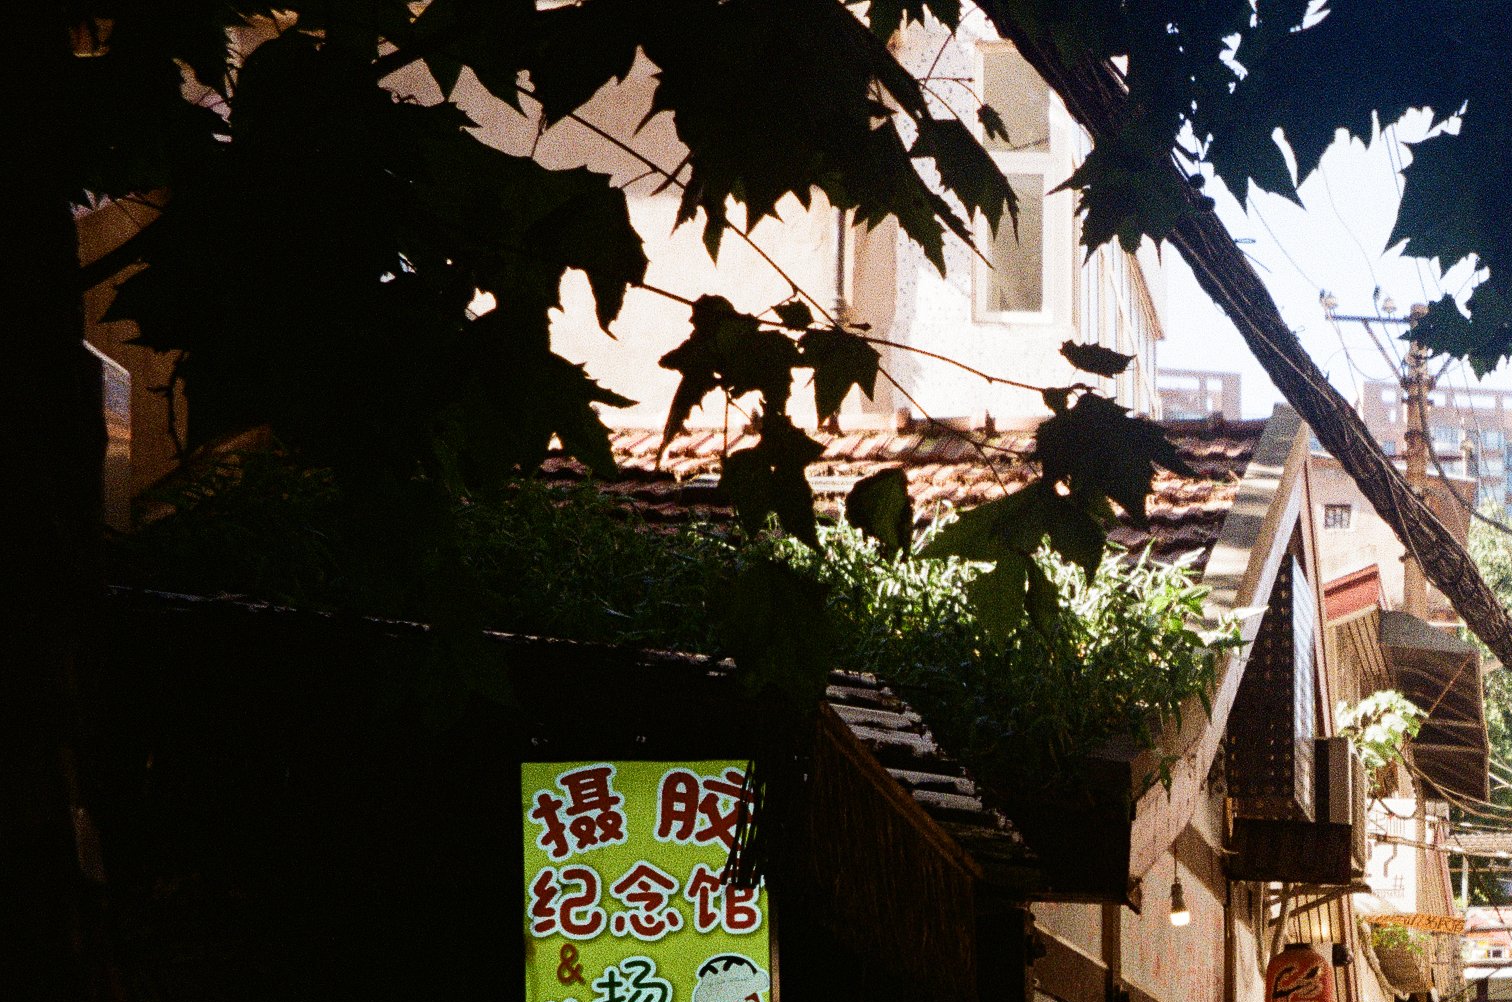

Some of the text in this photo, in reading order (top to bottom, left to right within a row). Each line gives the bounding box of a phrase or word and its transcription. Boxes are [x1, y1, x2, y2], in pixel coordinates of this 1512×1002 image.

[531, 766, 757, 859] 摄胶
[531, 865, 762, 938] 纪念馆
[556, 943, 585, 985] &
